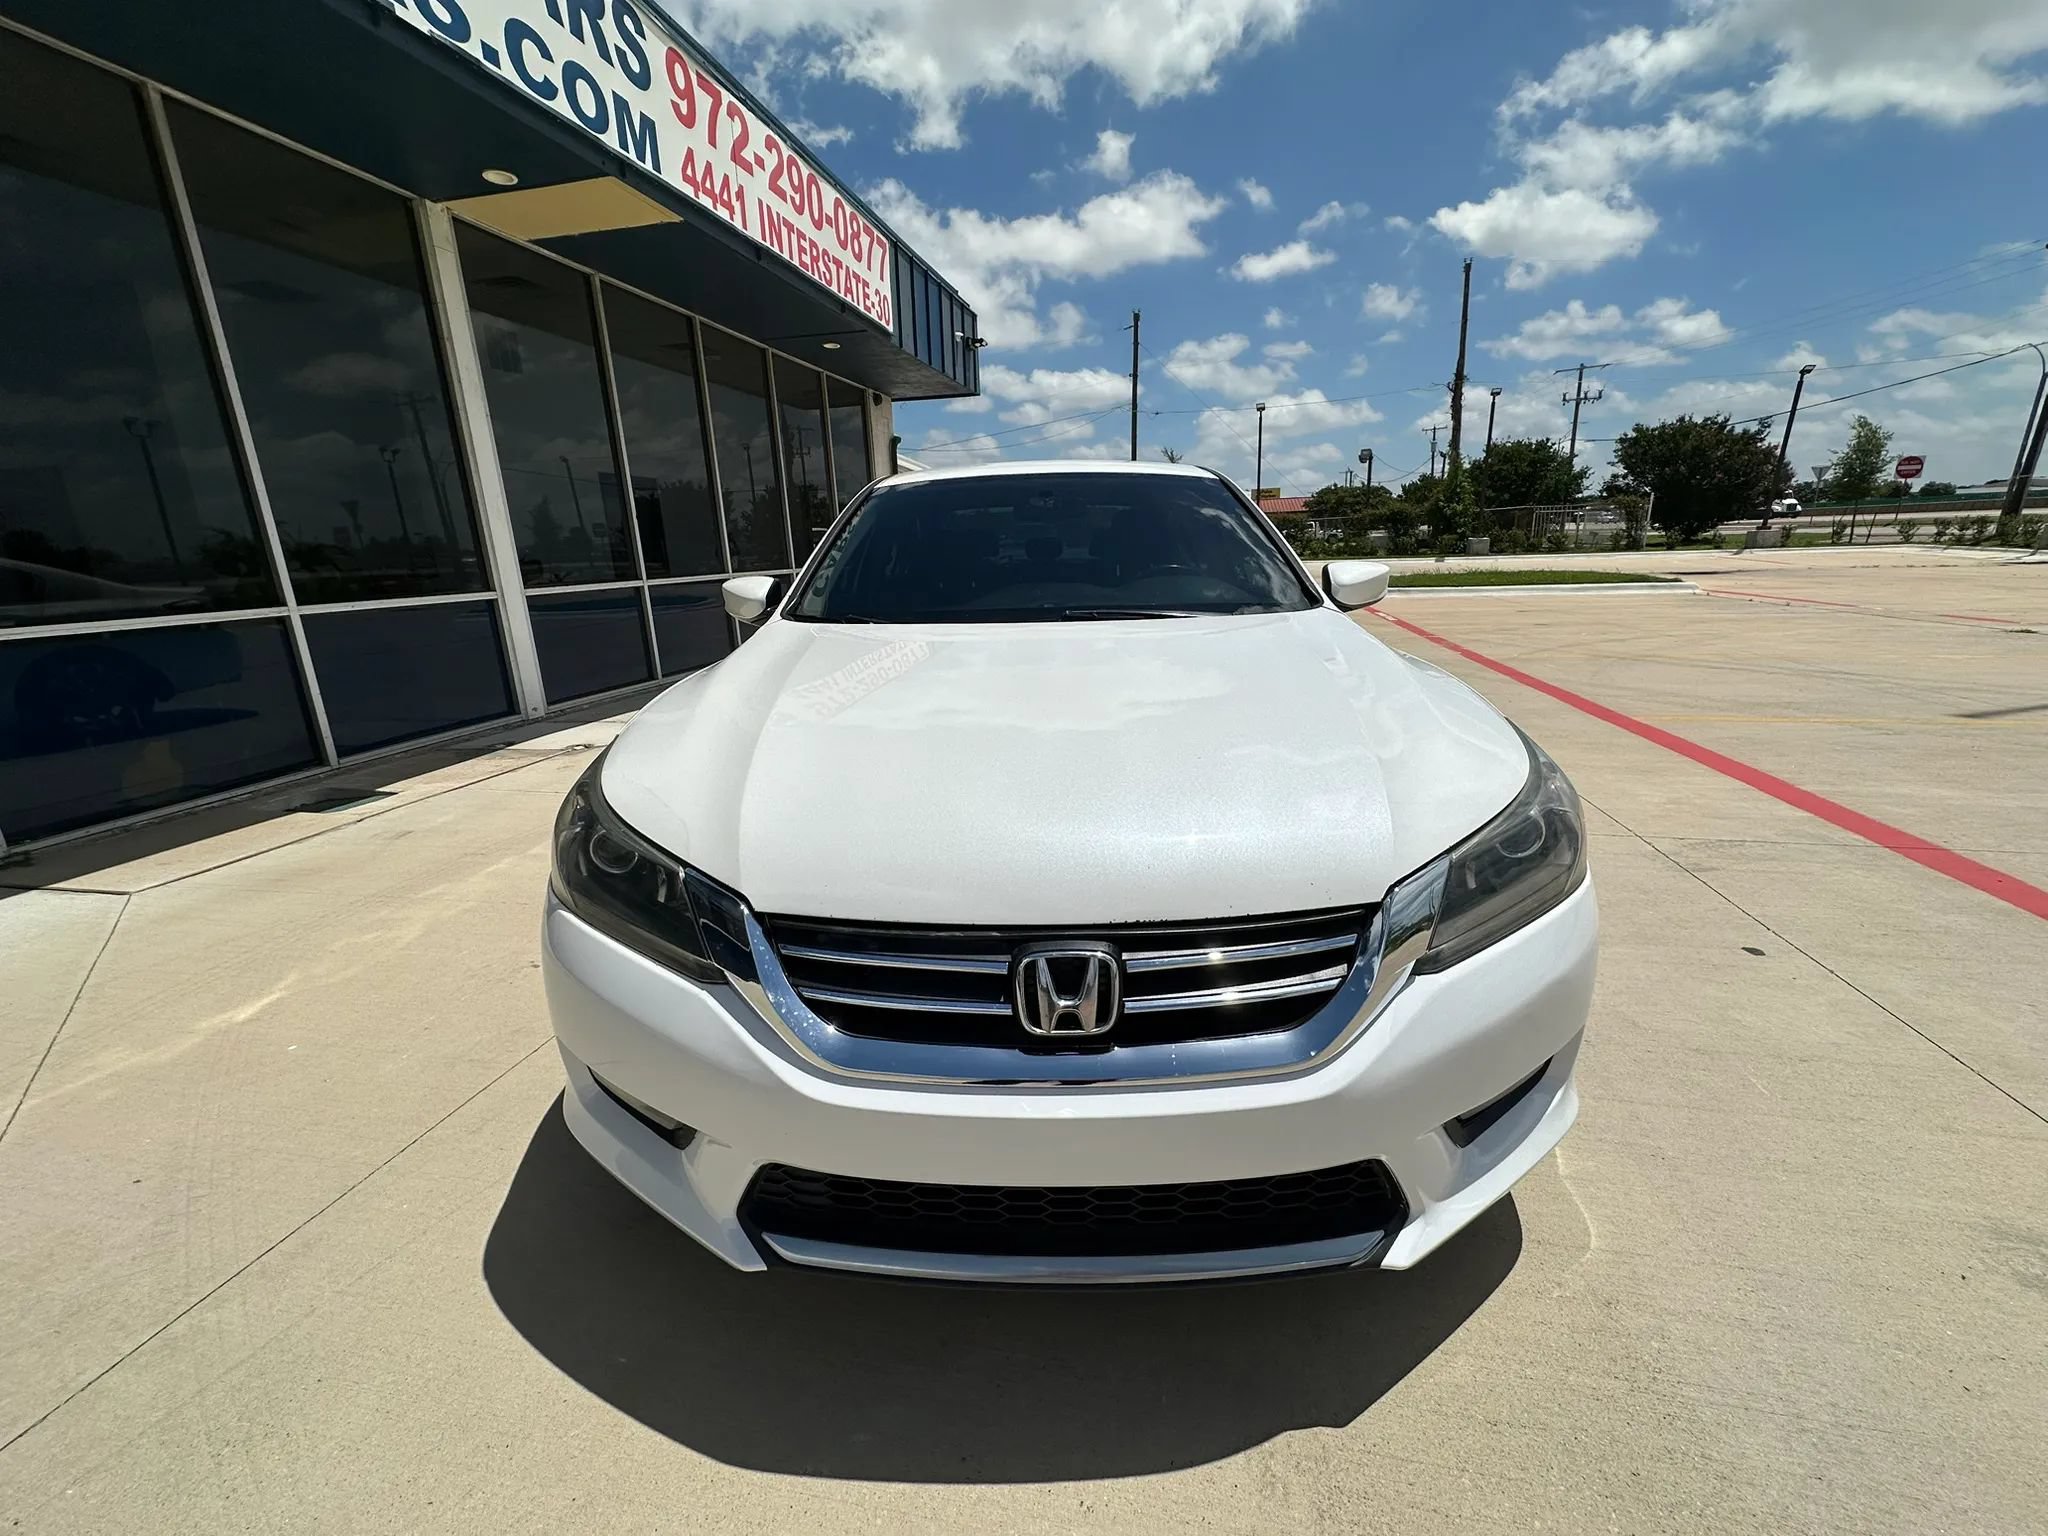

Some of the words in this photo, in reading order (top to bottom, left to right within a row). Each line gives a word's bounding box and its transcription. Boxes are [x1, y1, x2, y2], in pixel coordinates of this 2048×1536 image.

[665, 46, 889, 282] 972-290-0877
[681, 146, 748, 231] 4441
[758, 198, 891, 327] INTERSTATE-30
